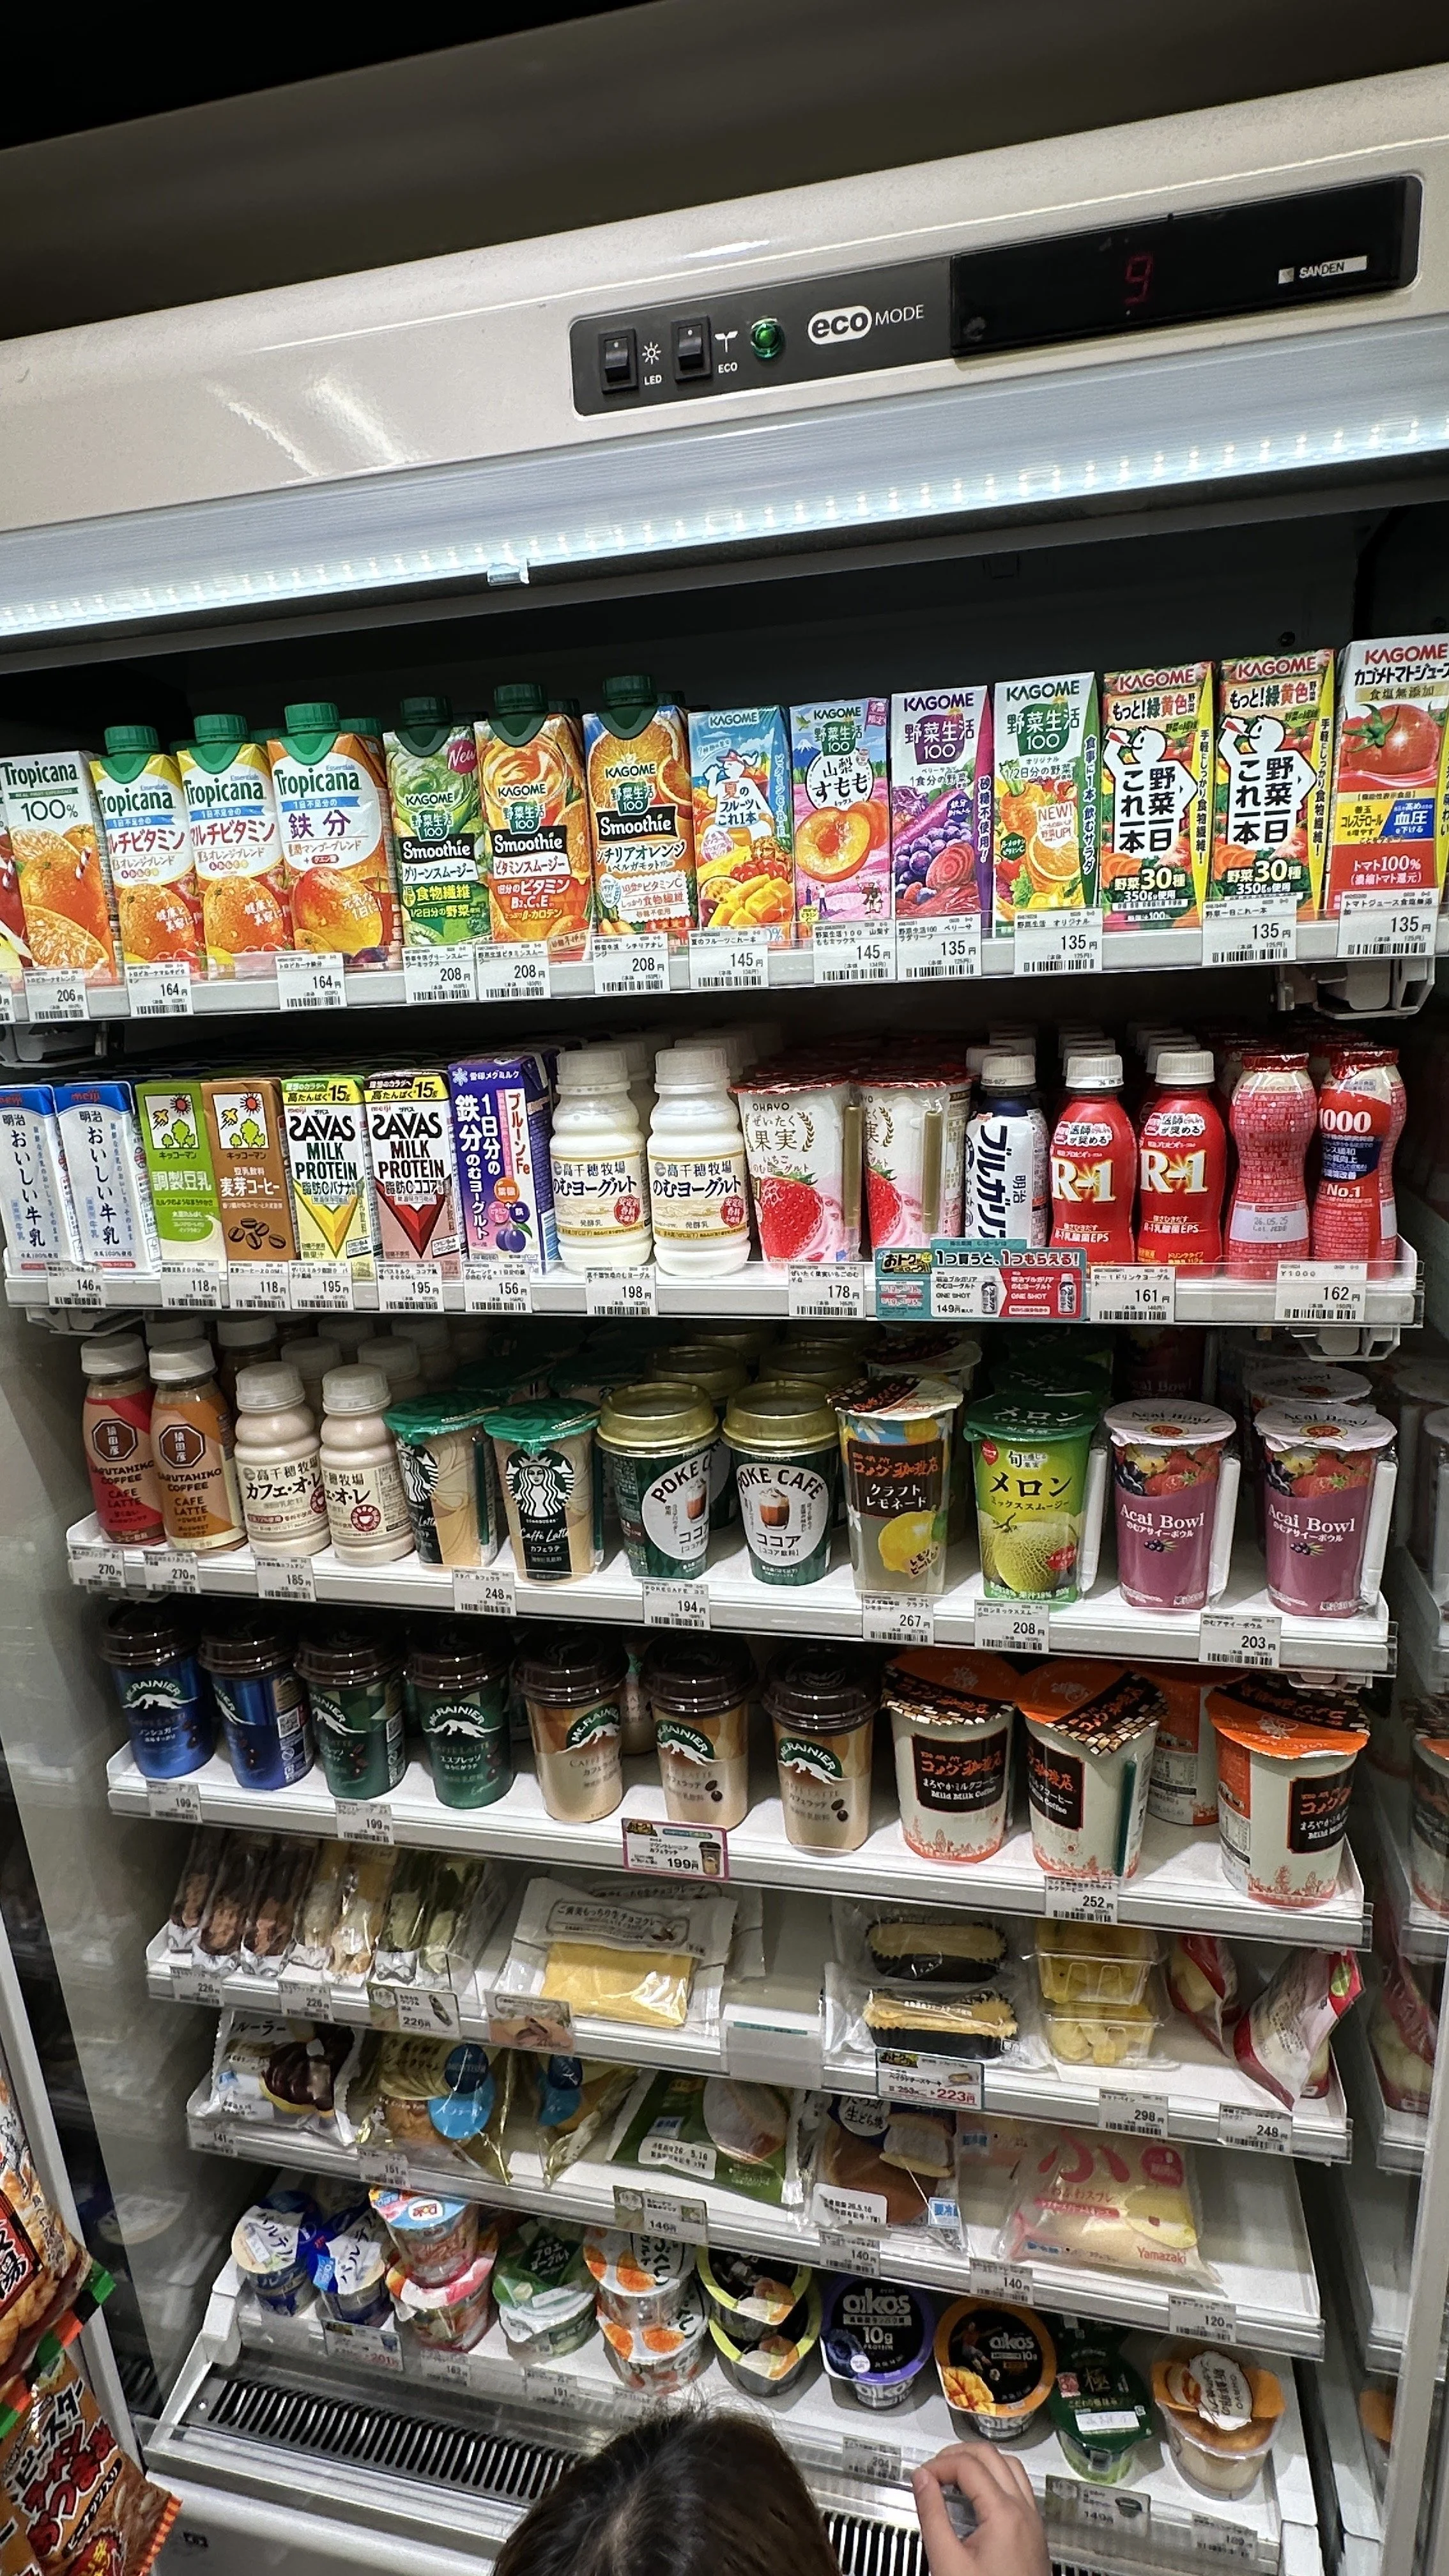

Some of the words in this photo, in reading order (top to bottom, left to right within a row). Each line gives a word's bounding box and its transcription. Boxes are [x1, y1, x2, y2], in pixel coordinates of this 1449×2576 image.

[1299, 261, 1345, 279] SANDEN
[811, 312, 868, 339] eco
[874, 303, 925, 326] MODE
[717, 362, 737, 374] ECO
[643, 374, 663, 385] LED
[1365, 643, 1448, 665] KAGOME
[1238, 656, 1317, 679] KAGOME
[1119, 668, 1194, 691] KAGOME
[1007, 680, 1080, 702] KAGOME
[1370, 685, 1435, 702] 食塩無添加
[904, 693, 974, 712] KAGOME
[710, 714, 758, 726] KAGOME
[814, 707, 861, 719] KAGOME
[1007, 707, 1080, 735] 野菜生活
[814, 725, 862, 742] 野菜生活
[905, 718, 974, 744] 野菜生活
[828, 742, 850, 752] 100
[1027, 735, 1060, 749] 100
[924, 744, 956, 759] 100
[1, 761, 77, 785] Tropicana
[606, 763, 656, 778] KAGOME
[274, 767, 361, 798] Tropicana
[498, 783, 546, 797] KAGOME
[813, 772, 868, 803] すもも
[183, 778, 264, 807] Tropicana
[406, 792, 454, 805] KAGOME
[1264, 757, 1294, 843] 野菜一日
[21, 799, 78, 821] 100%
[623, 801, 643, 811] 100
[1149, 767, 1177, 852] 野菜一日
[1233, 759, 1262, 845] これ一本
[718, 812, 756, 825] これ1本
[1038, 805, 1073, 822] NEW!
[1119, 769, 1146, 854] これ一本
[1393, 809, 1428, 827] 血圧
[288, 809, 351, 839] 鉄分
[515, 819, 534, 829] 100
[601, 815, 671, 835] Smoothie
[1341, 813, 1383, 829] コレステロール
[424, 828, 442, 837] 100
[1083, 806, 1096, 874] 飲むサラダ
[402, 839, 471, 859] Smoothie
[494, 832, 562, 854] Smoothie
[597, 841, 686, 862] シチリアオレンジ
[495, 855, 565, 875] ビタミンスムージー
[1353, 855, 1422, 873] トマト100%
[404, 863, 473, 882] グリーンスムージー
[1252, 923, 1291, 940] 135円
[1391, 916, 1431, 933] 135円
[940, 940, 976, 956] 135円
[1060, 935, 1097, 951] 135円
[730, 953, 763, 968] 145円
[856, 945, 891, 960] 145円
[514, 965, 545, 979] 208円
[632, 957, 664, 972] 208円
[440, 967, 470, 981] 208円
[160, 983, 188, 996] 164円
[312, 976, 341, 989] 164円
[57, 989, 83, 1002] 206円
[470, 1070, 519, 1081] 雪印メグミルク
[71, 1091, 100, 1103] meiji
[329, 1085, 351, 1101] 15g
[414, 1081, 437, 1098] 15g
[753, 1103, 790, 1111] OHAYO
[2, 1114, 26, 1126] 明治
[79, 1110, 103, 1123] 明治
[752, 1115, 795, 1128] ぜいたく
[289, 1116, 355, 1141] SAVAS
[372, 1112, 443, 1140] SAVAS
[480, 1096, 501, 1176] 1日分の
[508, 1093, 530, 1176] プルーンFe
[754, 1128, 797, 1151] 果実
[158, 1151, 197, 1160] キッコーマン
[226, 1151, 266, 1160] キッコーマン
[306, 1142, 343, 1160] MILK
[390, 1140, 430, 1159] MILK
[295, 1162, 358, 1180] PROTEIN
[378, 1160, 445, 1179] PROTEIN
[454, 1094, 489, 1239] 鉄分のむヨーグルト
[562, 1161, 626, 1177] 高千穂牧場
[666, 1160, 732, 1177] 高千穂牧場
[1140, 1149, 1208, 1193] R-1
[11, 1129, 46, 1248] おいしい牛乳
[86, 1126, 119, 1245] おいしい牛乳
[151, 1170, 213, 1192] 調製豆乳
[219, 1177, 280, 1197] 麦芽コーヒー
[553, 1176, 637, 1199] のむヨーグルト
[652, 1176, 742, 1198] のむヨーグルト
[1052, 1158, 1116, 1203] R-1
[1326, 1183, 1361, 1198] No.1
[936, 1249, 1080, 1266] 1つ買うと、1つもらえる!
[77, 1279, 101, 1292] 146円
[191, 1279, 217, 1292] 118円
[260, 1280, 286, 1294] 118円
[322, 1281, 349, 1294] 195円
[411, 1281, 439, 1294] 195円
[498, 1282, 527, 1296] 156円
[621, 1285, 652, 1300] 198円
[827, 1285, 860, 1300] 178円
[1134, 1289, 1170, 1303] 161円
[1322, 1286, 1360, 1302] 162円
[995, 1406, 1084, 1422] メロン
[1009, 1451, 1023, 1468] 旬
[101, 1474, 142, 1485] COFFEE
[167, 1482, 209, 1492] COFFEE
[989, 1472, 1073, 1498] メロン
[109, 1488, 138, 1499] CAFE
[870, 1483, 921, 1496] クラフト
[107, 1497, 142, 1508] LATTE
[174, 1496, 204, 1506] CAFE
[866, 1496, 928, 1510] レモネード
[174, 1505, 208, 1516] LATTE
[1120, 1503, 1153, 1527] Acai
[1160, 1512, 1204, 1529] Bowl
[1268, 1503, 1300, 1529] Acai
[1306, 1517, 1356, 1533] Bowl
[756, 1532, 802, 1548] ココア
[98, 1563, 123, 1576] 270円
[171, 1567, 195, 1581] 270円
[286, 1573, 312, 1586] 185円
[485, 1587, 512, 1602] 248円
[677, 1599, 706, 1614] 194円
[900, 1614, 931, 1628] 267円
[1013, 1621, 1045, 1636] 208円
[1241, 1635, 1276, 1650] 203円
[365, 1819, 390, 1832] 199円
[666, 1857, 700, 1871] 199円
[1082, 1895, 1114, 1910] 252円
[937, 2088, 976, 2104] 223円
[1133, 2109, 1165, 2124] 298円
[1256, 2125, 1289, 2139] 248円
[850, 2248, 877, 2263] 140円
[1136, 2245, 1188, 2266] Yamazaki
[1002, 2276, 1030, 2291] 140円
[843, 2288, 911, 2314] oikos
[863, 2326, 893, 2345] 10g
